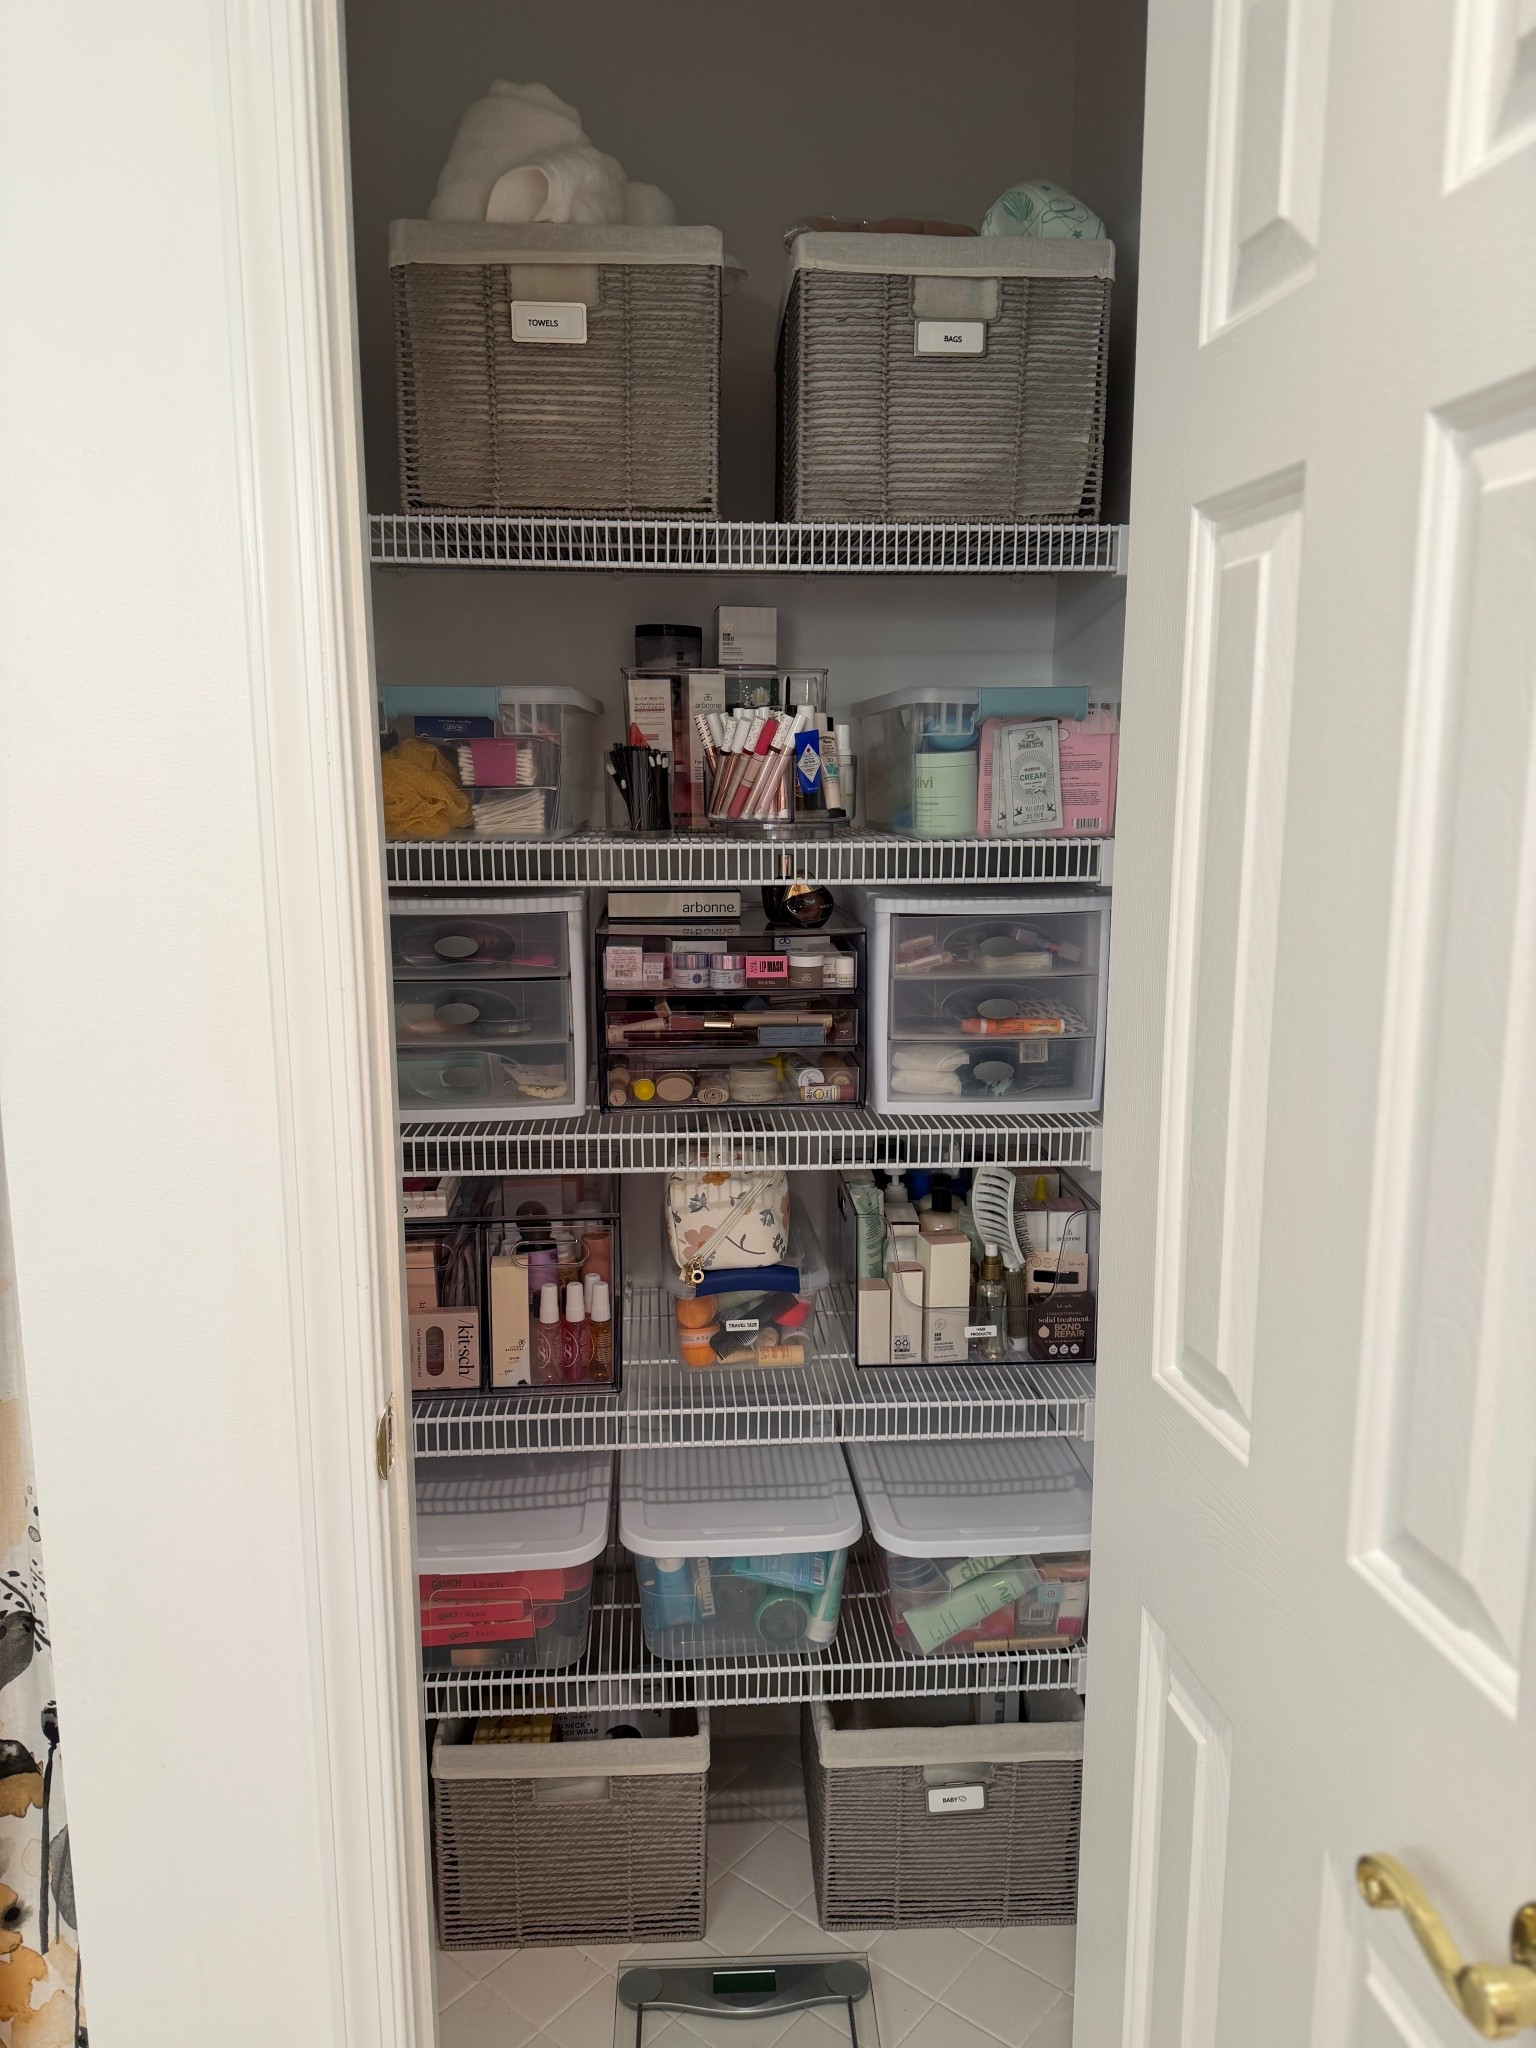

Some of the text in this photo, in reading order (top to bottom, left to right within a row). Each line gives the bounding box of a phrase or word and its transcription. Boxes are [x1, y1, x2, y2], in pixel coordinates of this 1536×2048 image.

[528, 319, 559, 327] TOWELS
[944, 335, 963, 343] BAGS
[1020, 772, 1046, 782] CREAM
[682, 902, 736, 912] arbonne.
[767, 961, 784, 972] MASK
